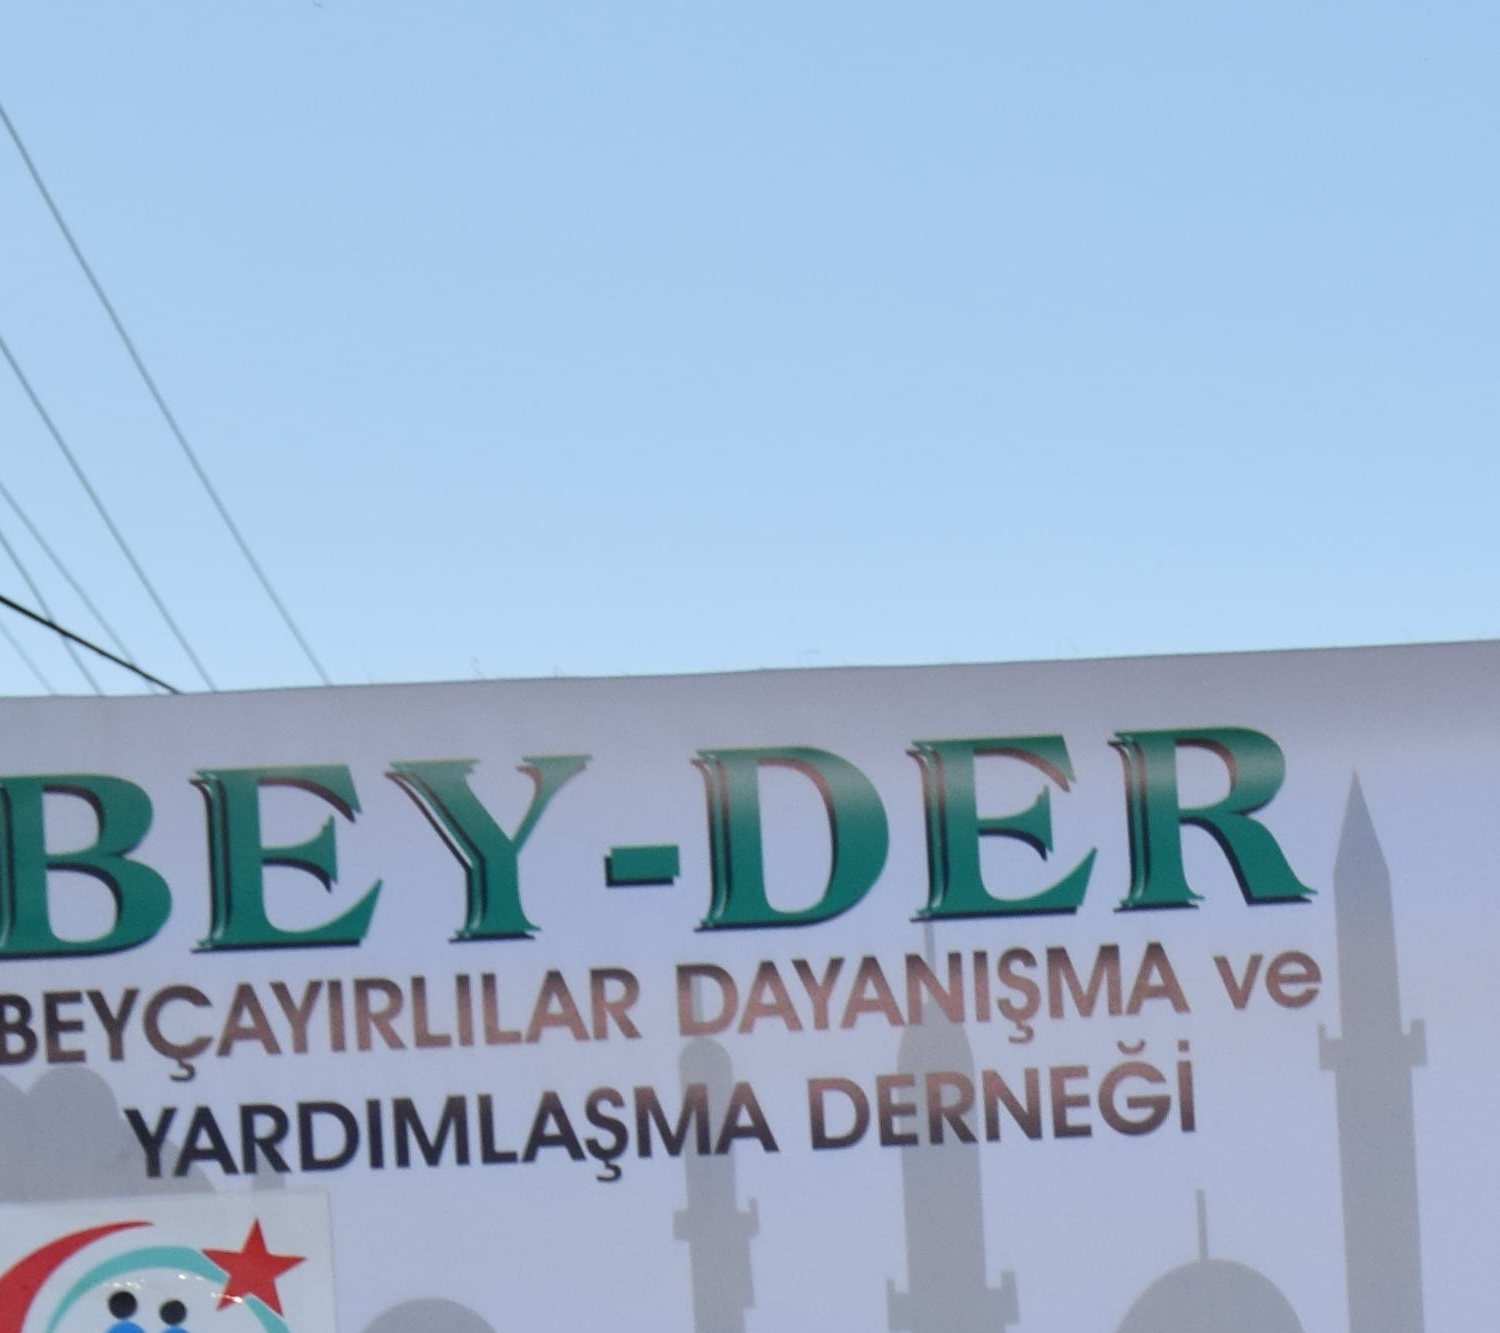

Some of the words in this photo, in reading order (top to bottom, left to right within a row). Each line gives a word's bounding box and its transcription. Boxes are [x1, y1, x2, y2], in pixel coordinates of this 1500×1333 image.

[675, 942, 1190, 1044] DAYANIŞMA
[1213, 950, 1322, 1010] ve
[123, 1082, 780, 1183] YARDIMLAŞMA
[807, 1039, 1196, 1151] DERNEĞİ
